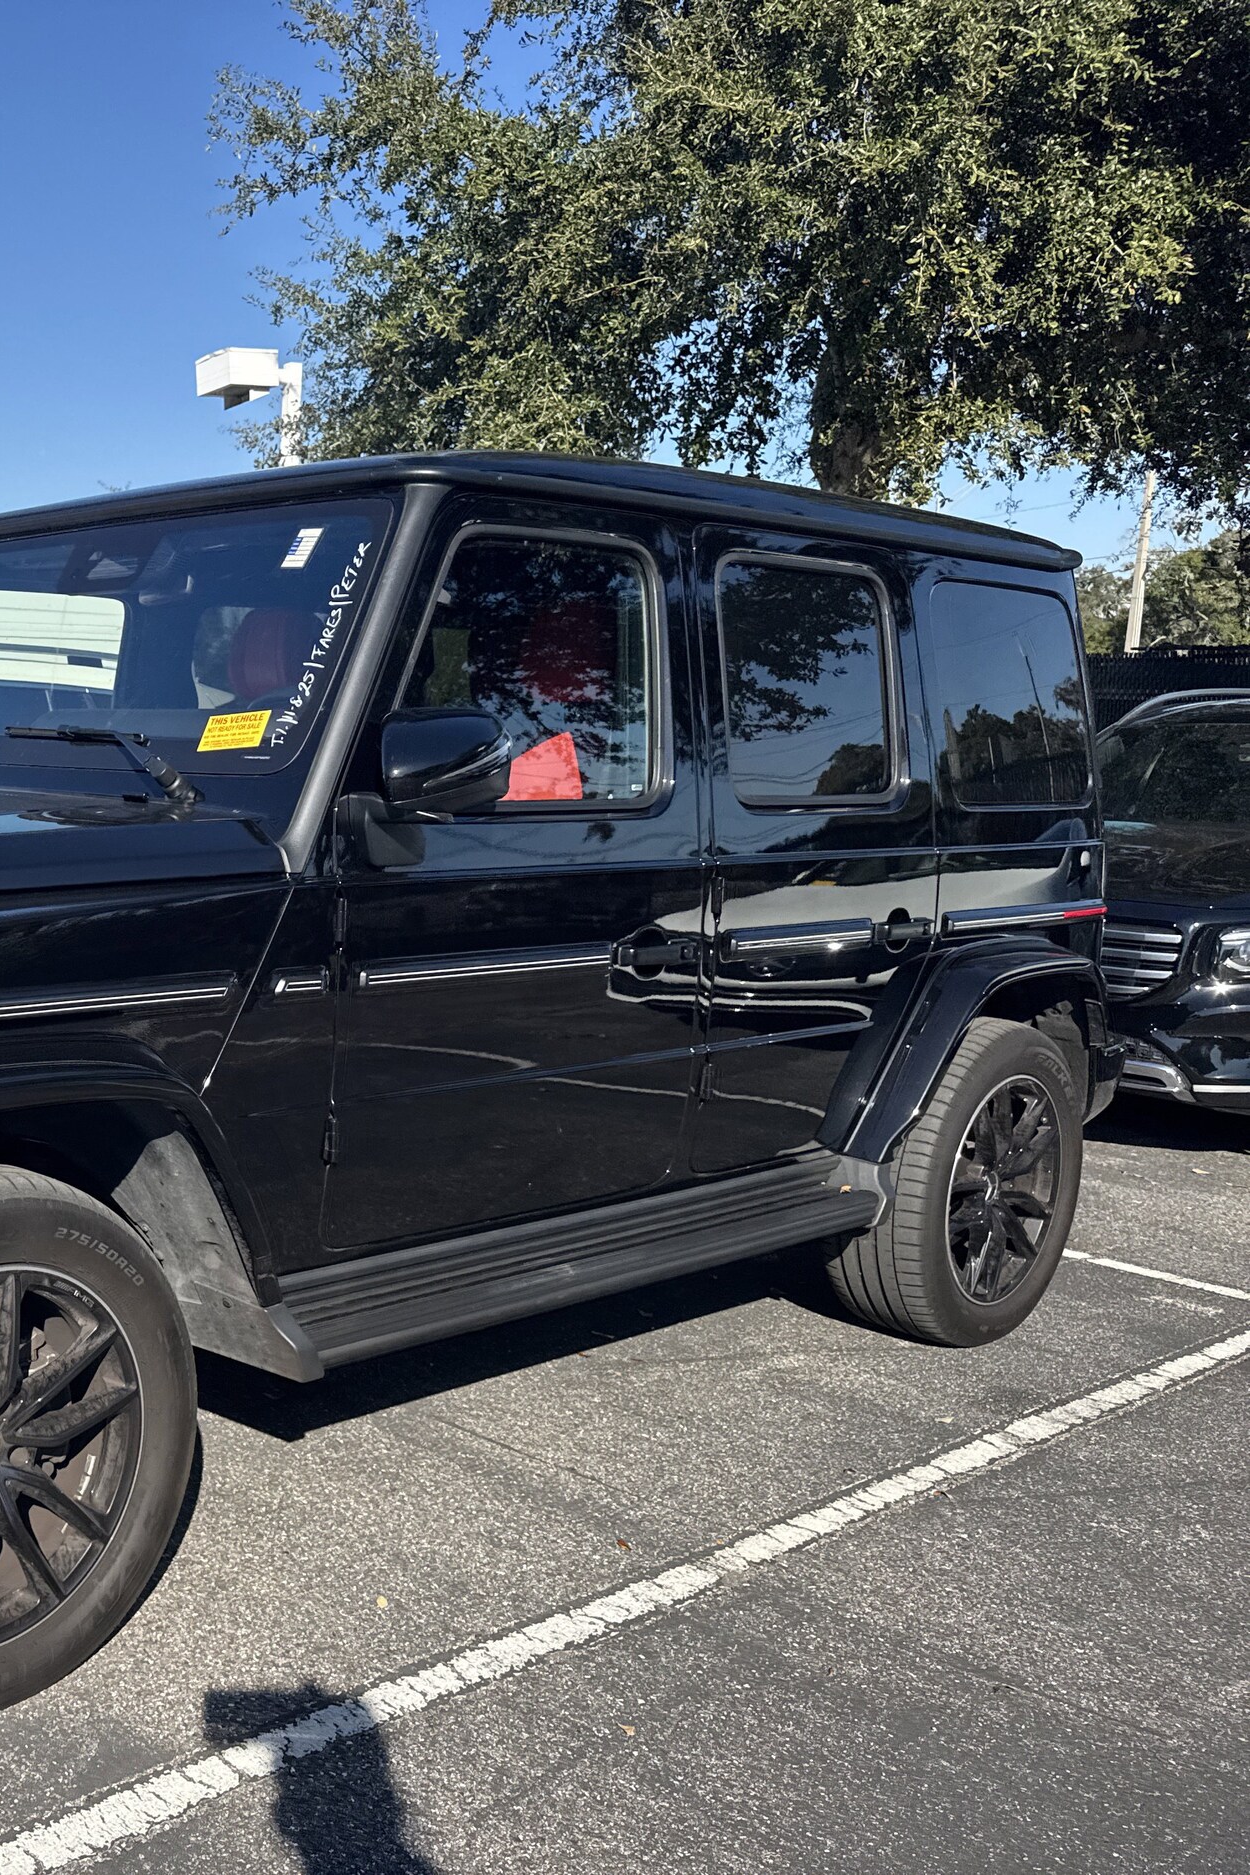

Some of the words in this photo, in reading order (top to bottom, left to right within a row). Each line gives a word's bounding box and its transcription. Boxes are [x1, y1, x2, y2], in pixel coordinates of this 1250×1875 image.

[330, 541, 372, 598] PETER
[210, 716, 229, 726] THIS
[230, 712, 266, 724] VEHICLE
[54, 1227, 145, 1287] 275/50R20
